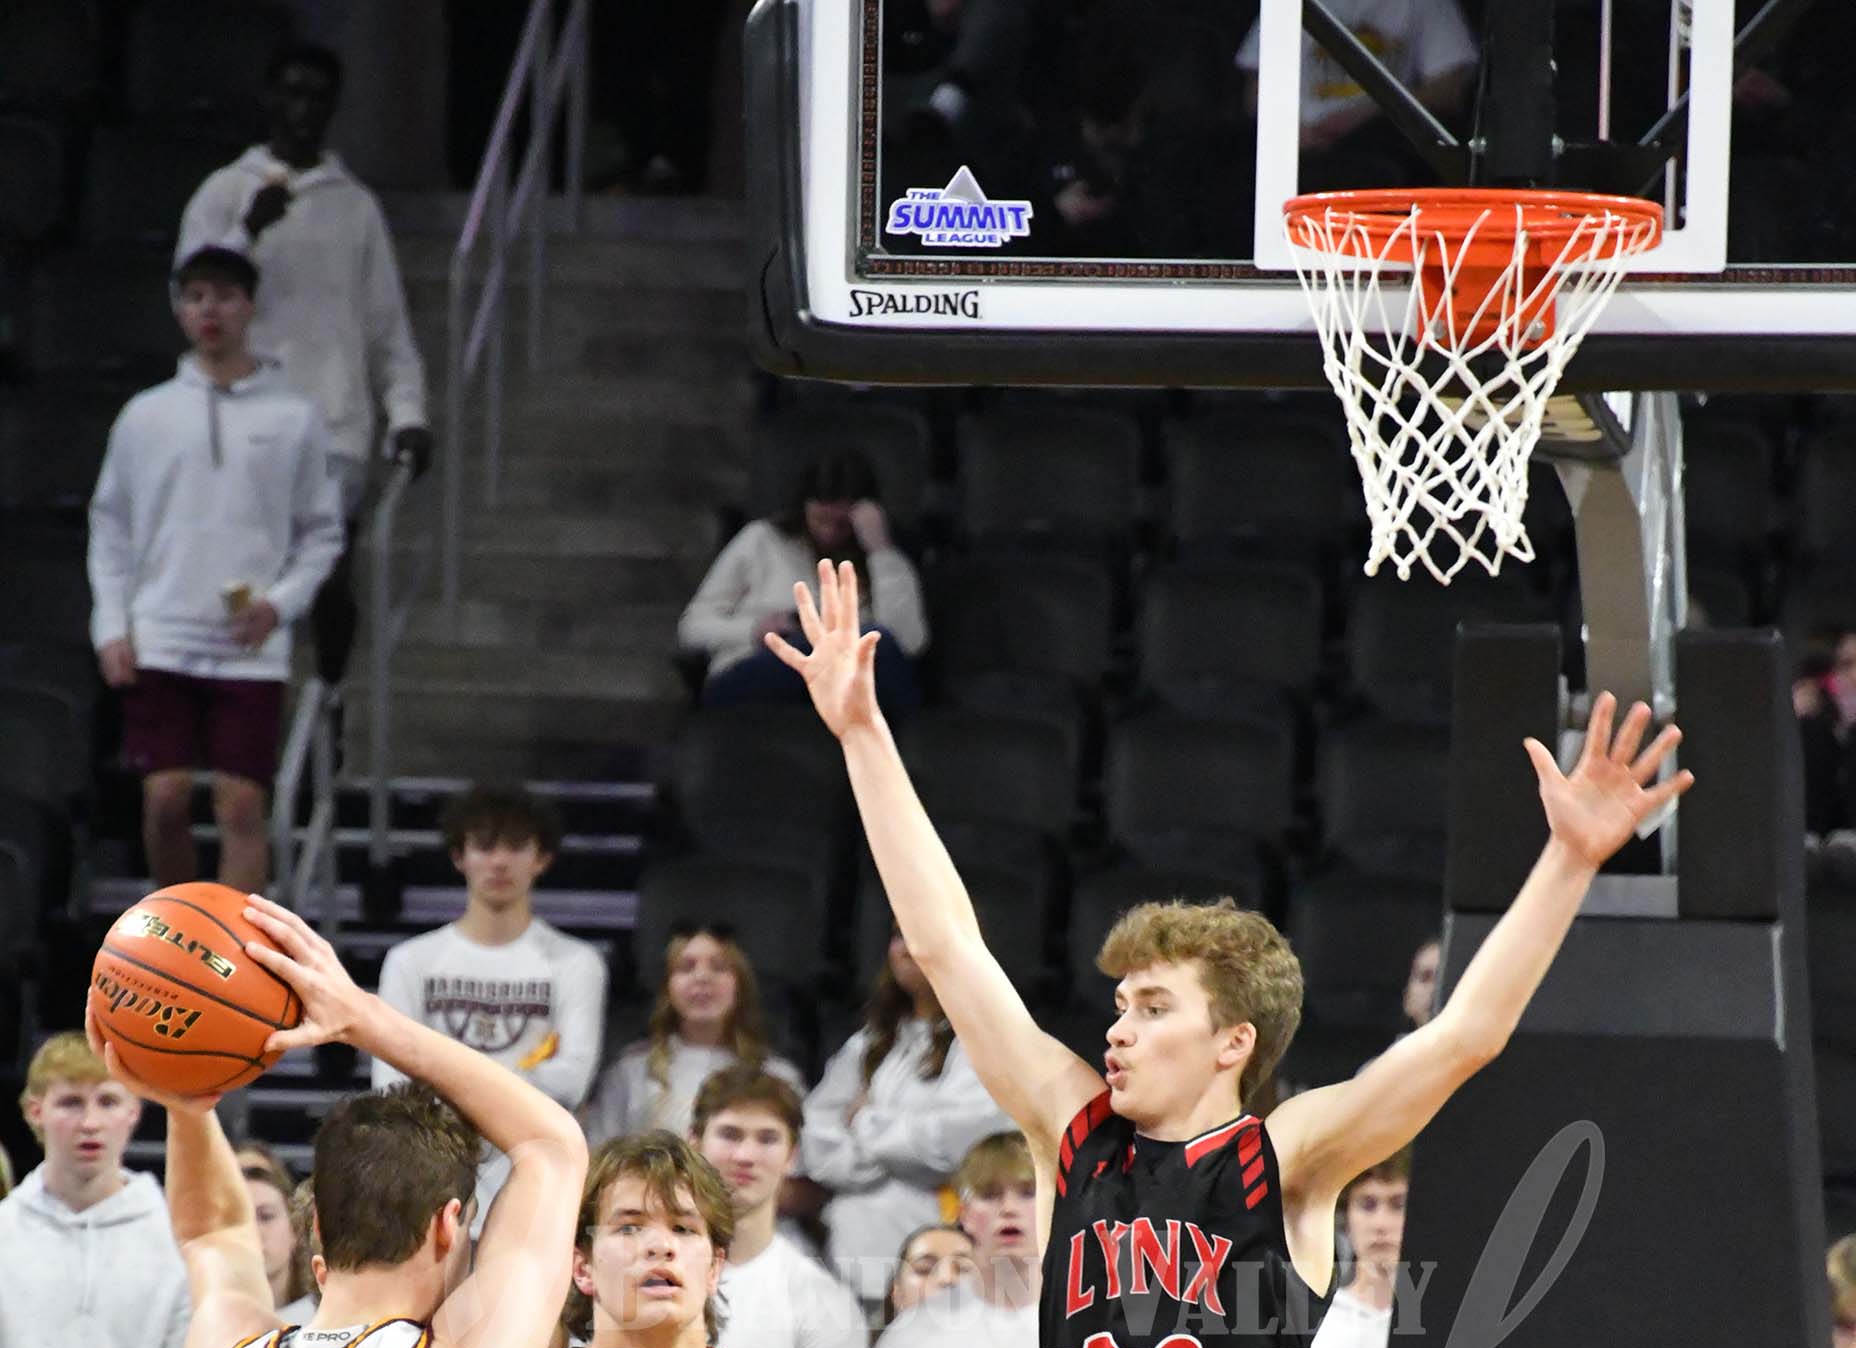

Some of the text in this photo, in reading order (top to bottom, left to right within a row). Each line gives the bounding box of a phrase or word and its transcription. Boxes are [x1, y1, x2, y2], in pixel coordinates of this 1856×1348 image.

[910, 191, 941, 200] THE
[894, 204, 1026, 230] SUMMIT
[925, 233, 998, 243] LEAGUE
[849, 289, 981, 319] SPALDING
[95, 972, 202, 1040] Baden
[1066, 1217, 1233, 1319] LYNX
[317, 1331, 351, 1342] PRO
